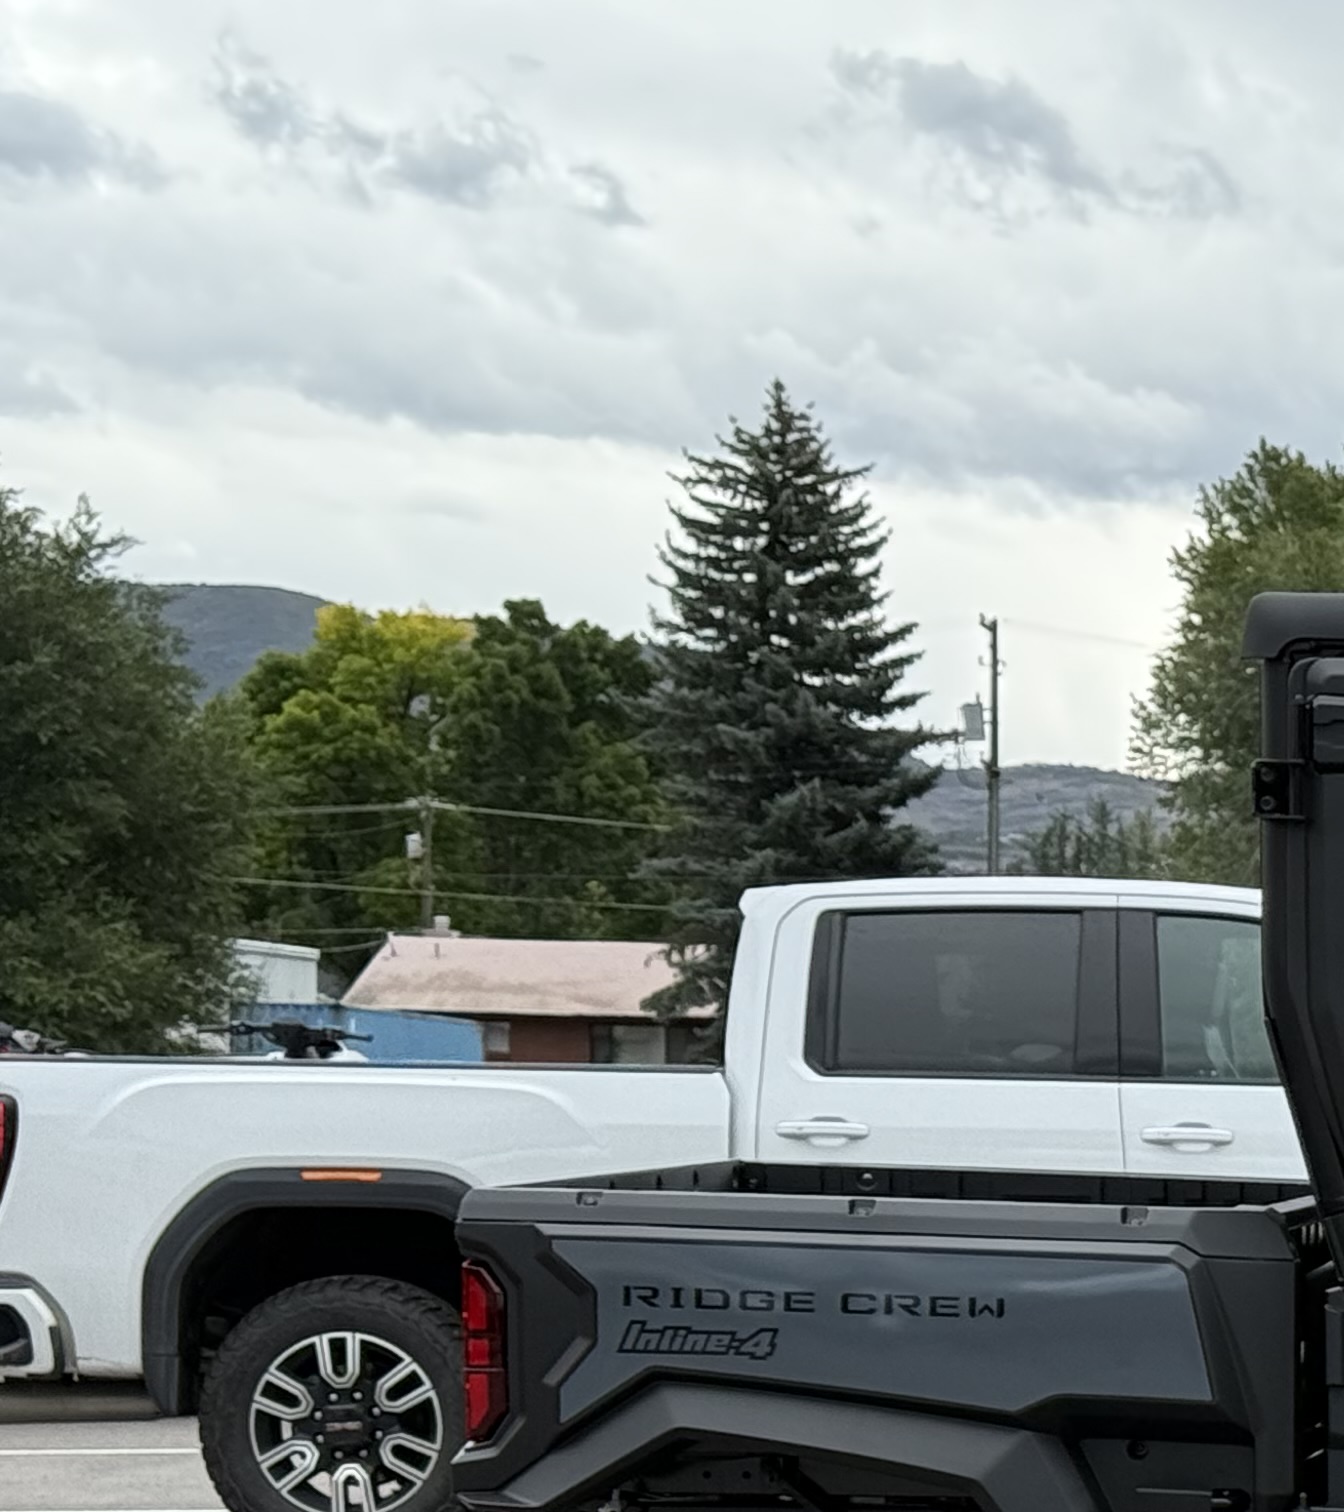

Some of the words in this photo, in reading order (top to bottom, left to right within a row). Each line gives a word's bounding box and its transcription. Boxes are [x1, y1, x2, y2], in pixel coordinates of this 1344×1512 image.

[623, 1285, 816, 1313] RIDGE
[840, 1292, 1005, 1318] CREW
[617, 1320, 780, 1360] Inline-4
